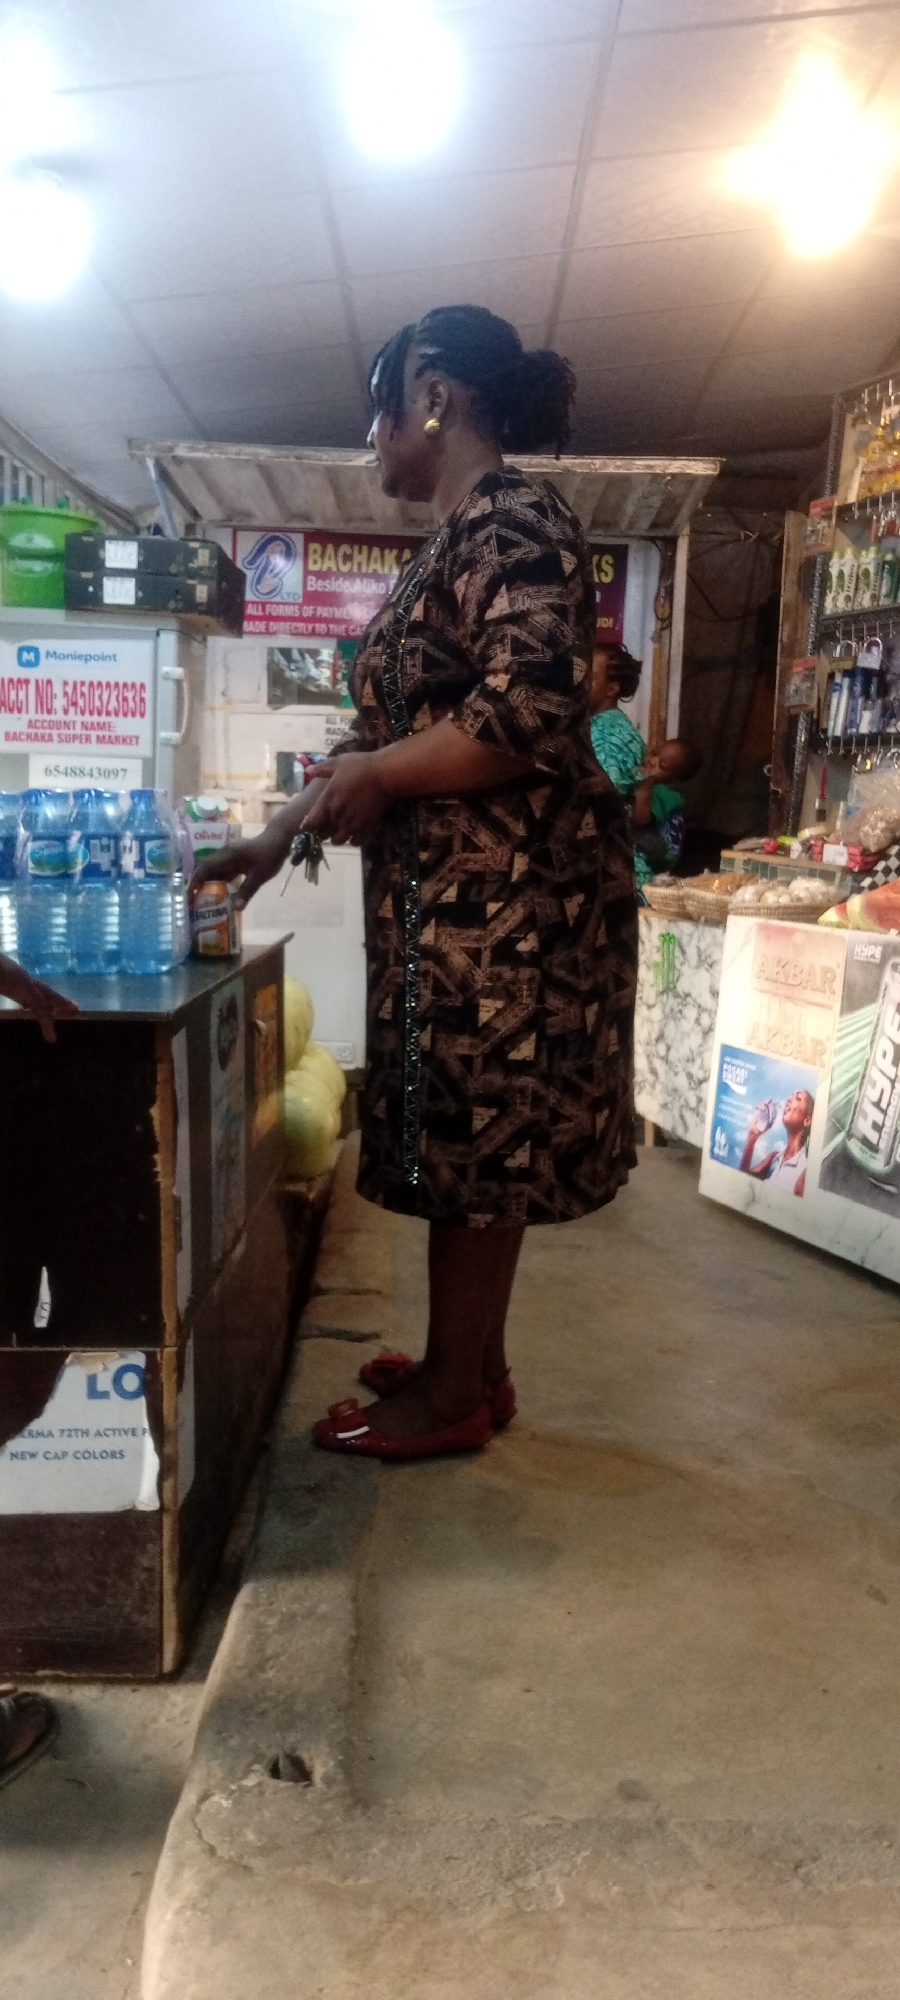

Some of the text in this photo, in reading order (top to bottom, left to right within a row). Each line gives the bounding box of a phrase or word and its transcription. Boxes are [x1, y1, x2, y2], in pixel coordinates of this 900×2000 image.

[307, 576, 351, 593] Beside
[246, 603, 263, 616] ALL
[265, 604, 300, 617] FORMS
[302, 606, 315, 617] OF
[268, 621, 315, 635] DIRECTLY
[315, 623, 328, 634] TO
[329, 623, 347, 636] THE
[45, 650, 117, 663] Moniepoint
[0, 677, 147, 719] ACCT NO: 5450323636
[27, 719, 117, 732] ACCOUNT NAME:
[4, 731, 140, 746] BACHAKA SUPER MARKET
[44, 765, 128, 780] 6548843097
[854, 943, 882, 959] HYPE
[755, 954, 836, 995] AKBAR
[746, 1022, 826, 1068] AKBAR
[857, 1003, 900, 1146] HYPE
[86, 1363, 145, 1400] LO
[58, 1428, 90, 1438] 72TH
[93, 1427, 138, 1438] ACTIVE
[10, 1449, 125, 1460] NEW CAP COLORS
